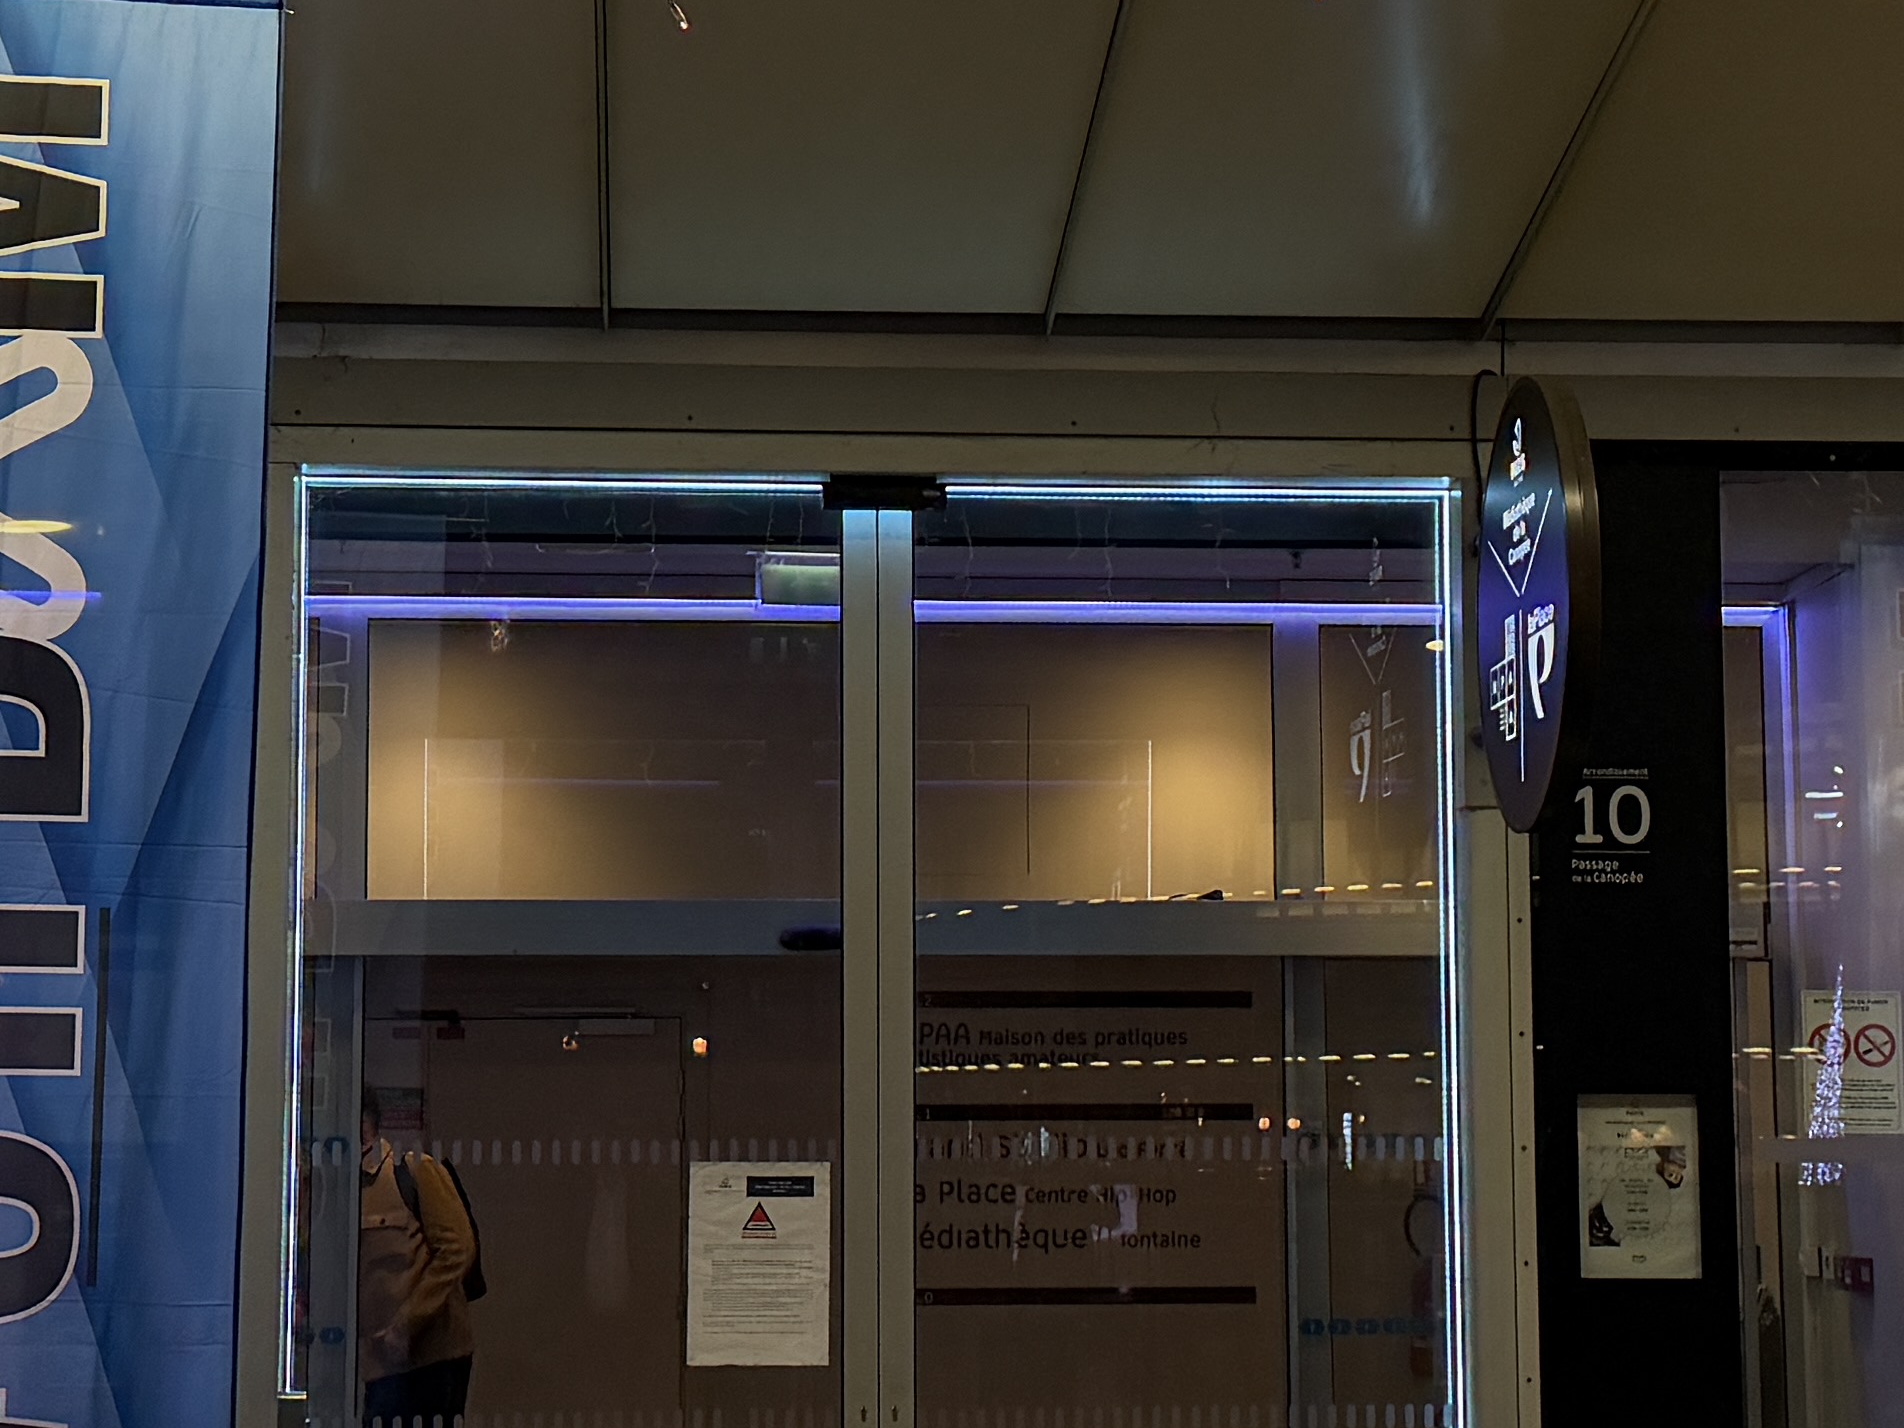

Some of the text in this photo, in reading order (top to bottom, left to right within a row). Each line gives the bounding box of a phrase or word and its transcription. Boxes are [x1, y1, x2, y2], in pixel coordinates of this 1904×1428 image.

[1574, 785, 1651, 845] 10
[1571, 859, 1619, 872] Passage
[979, 1029, 1045, 1045] Maison
[1053, 1029, 1087, 1045] des
[1095, 1029, 1189, 1049] pratiques
[939, 1179, 1017, 1204] Place
[1025, 1187, 1089, 1204] Centre
[1139, 1186, 1178, 1207] Hop
